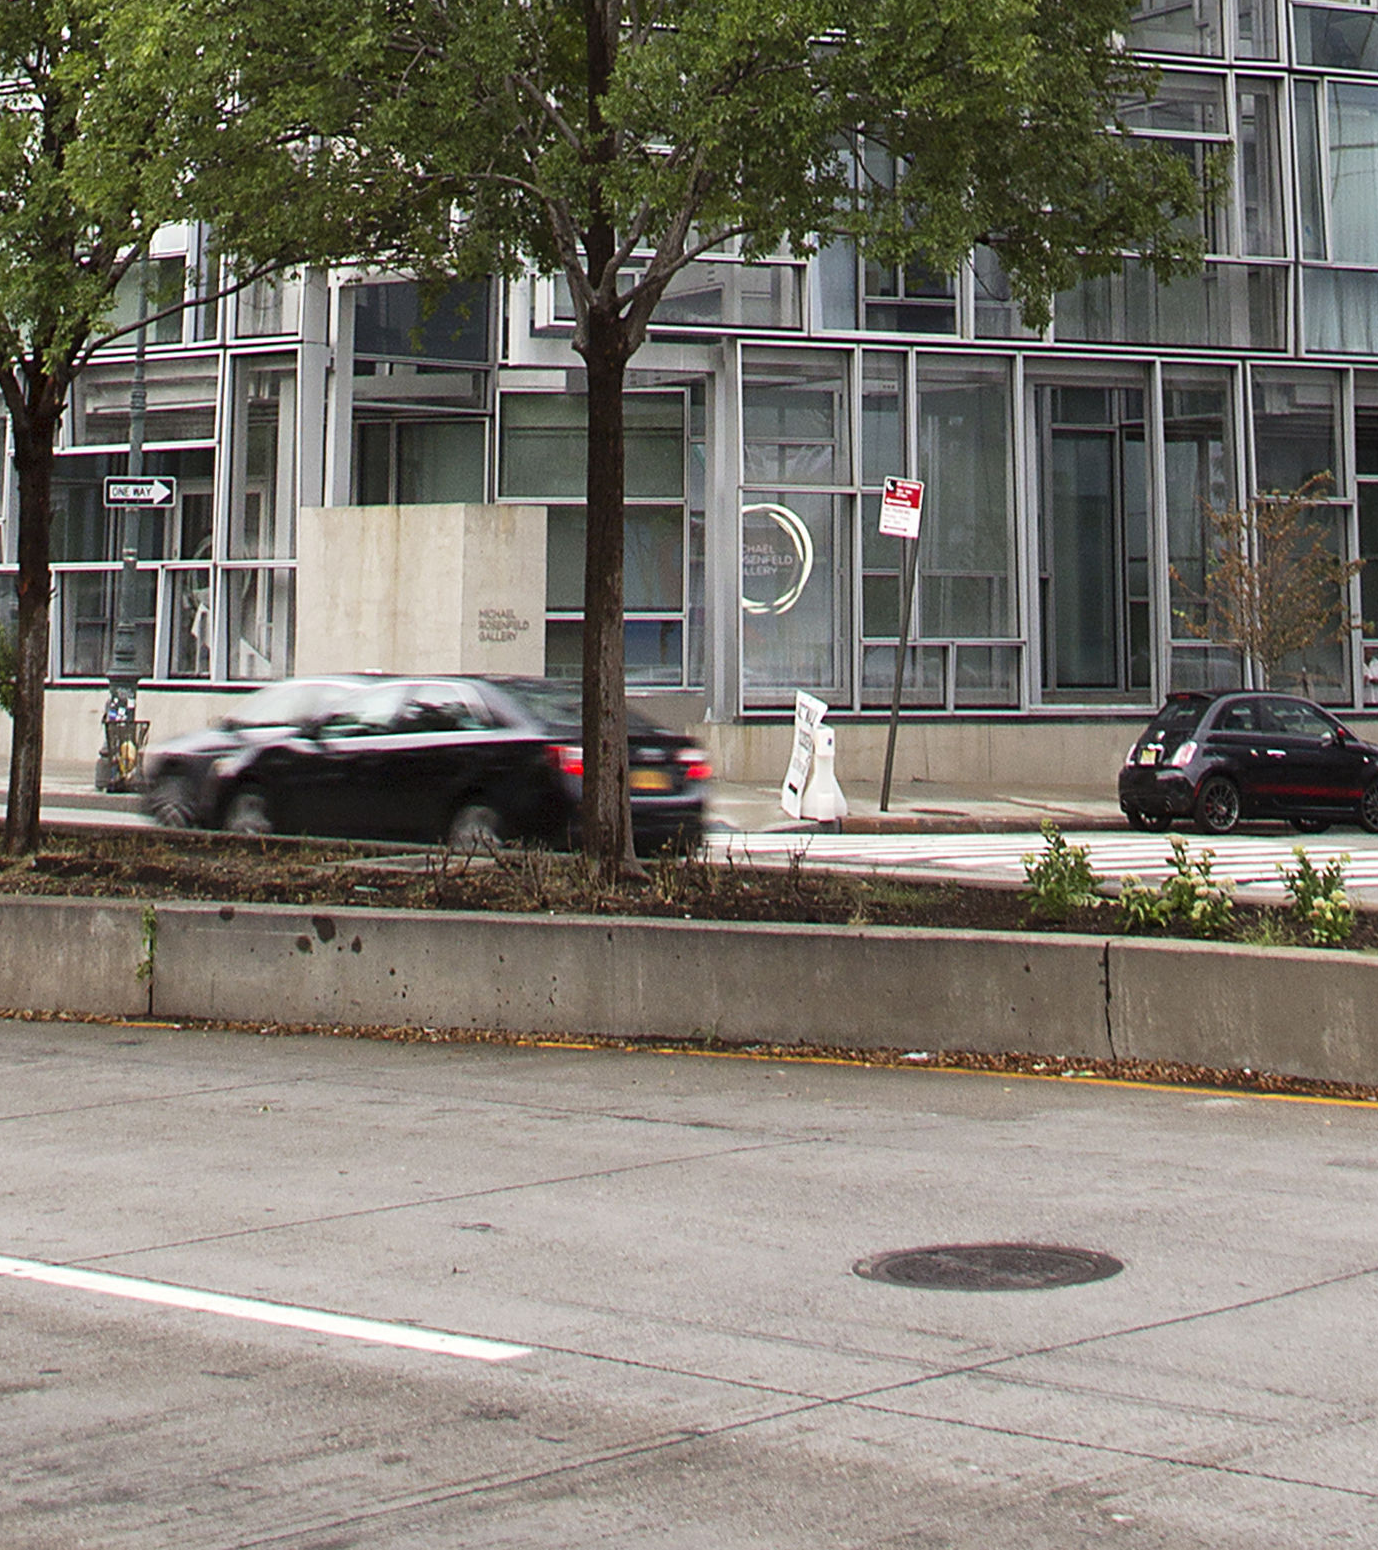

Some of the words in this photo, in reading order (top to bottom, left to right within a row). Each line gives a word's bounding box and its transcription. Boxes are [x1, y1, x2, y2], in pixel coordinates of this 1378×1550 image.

[112, 485, 130, 497] ONE
[133, 485, 153, 497] WAY
[743, 565, 778, 576] LLERY
[479, 608, 516, 619] MICHAEL
[478, 619, 530, 631] ROSENFELD
[478, 630, 518, 642] GALLERY
